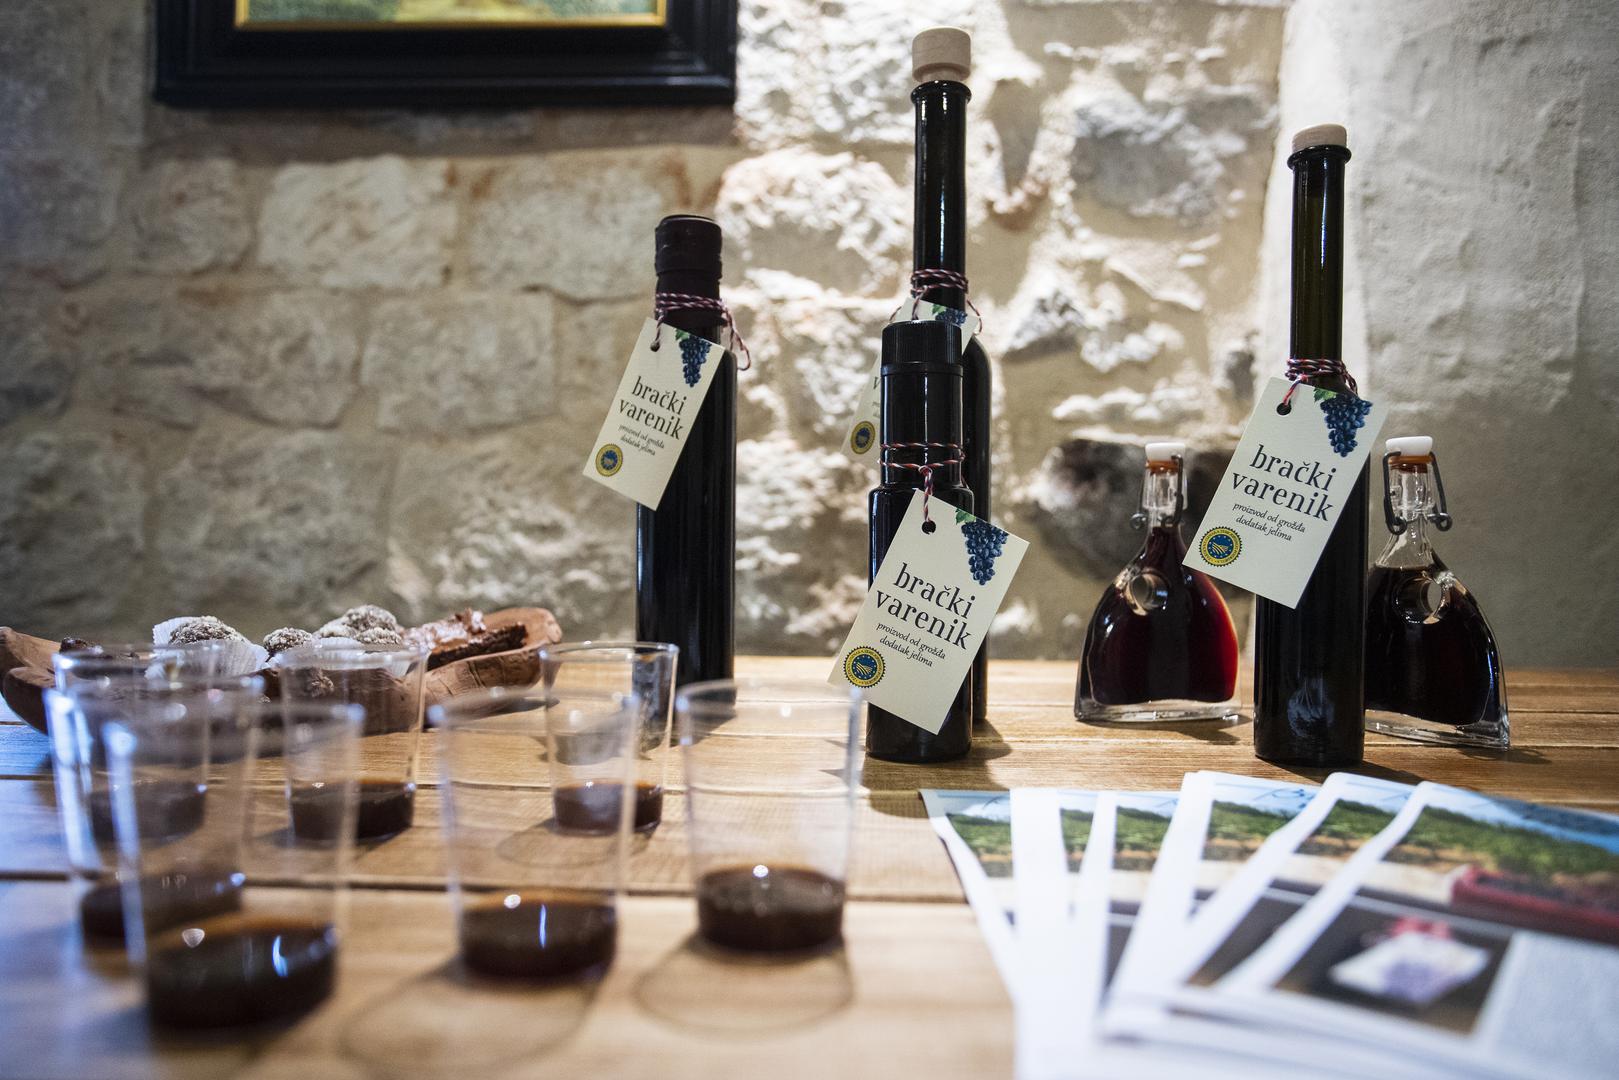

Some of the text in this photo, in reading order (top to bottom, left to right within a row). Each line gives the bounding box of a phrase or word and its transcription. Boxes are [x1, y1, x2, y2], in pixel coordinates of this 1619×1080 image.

[632, 375, 687, 415] brački
[619, 399, 683, 440] varenik
[1249, 443, 1337, 492] brački
[1231, 472, 1334, 521] varenik
[1232, 503, 1268, 518] proizvod
[1267, 514, 1280, 523] od
[1236, 515, 1292, 541] dodatak jelima
[894, 562, 976, 619] brački
[876, 590, 972, 650] varenik
[876, 622, 911, 642] proizvod
[909, 638, 921, 647] od
[879, 636, 910, 654] dodatak
[907, 650, 933, 668] jelima
